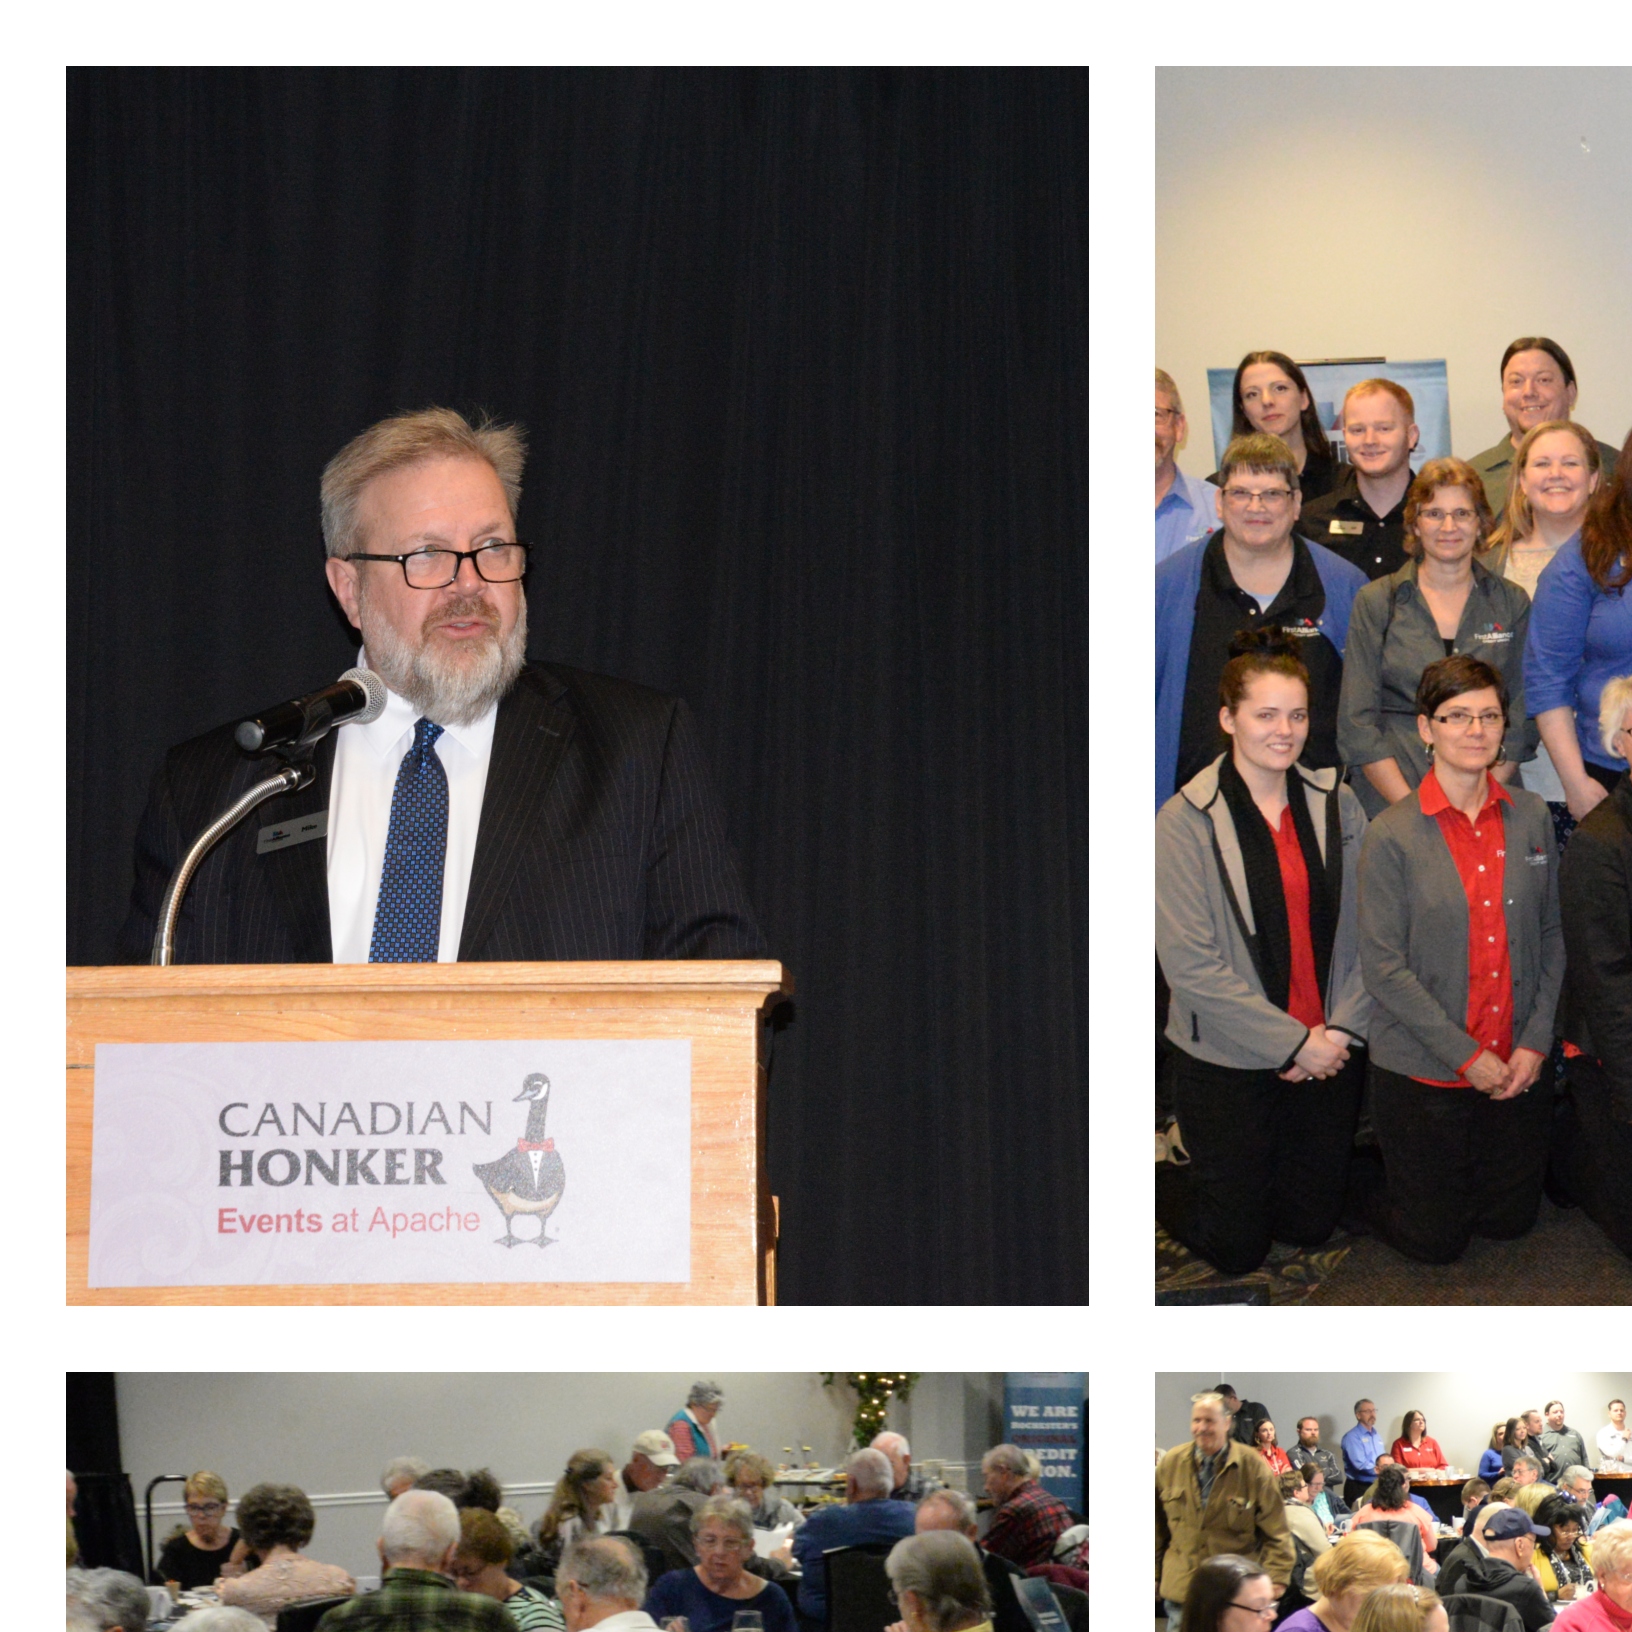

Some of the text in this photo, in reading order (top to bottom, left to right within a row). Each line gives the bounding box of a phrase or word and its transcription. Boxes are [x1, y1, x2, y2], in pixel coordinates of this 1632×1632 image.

[218, 1101, 493, 1137] CANADIAN
[217, 1148, 448, 1187] HONKER
[217, 1206, 481, 1238] Events at Apache
[1010, 1405, 1079, 1417] WE ARE
